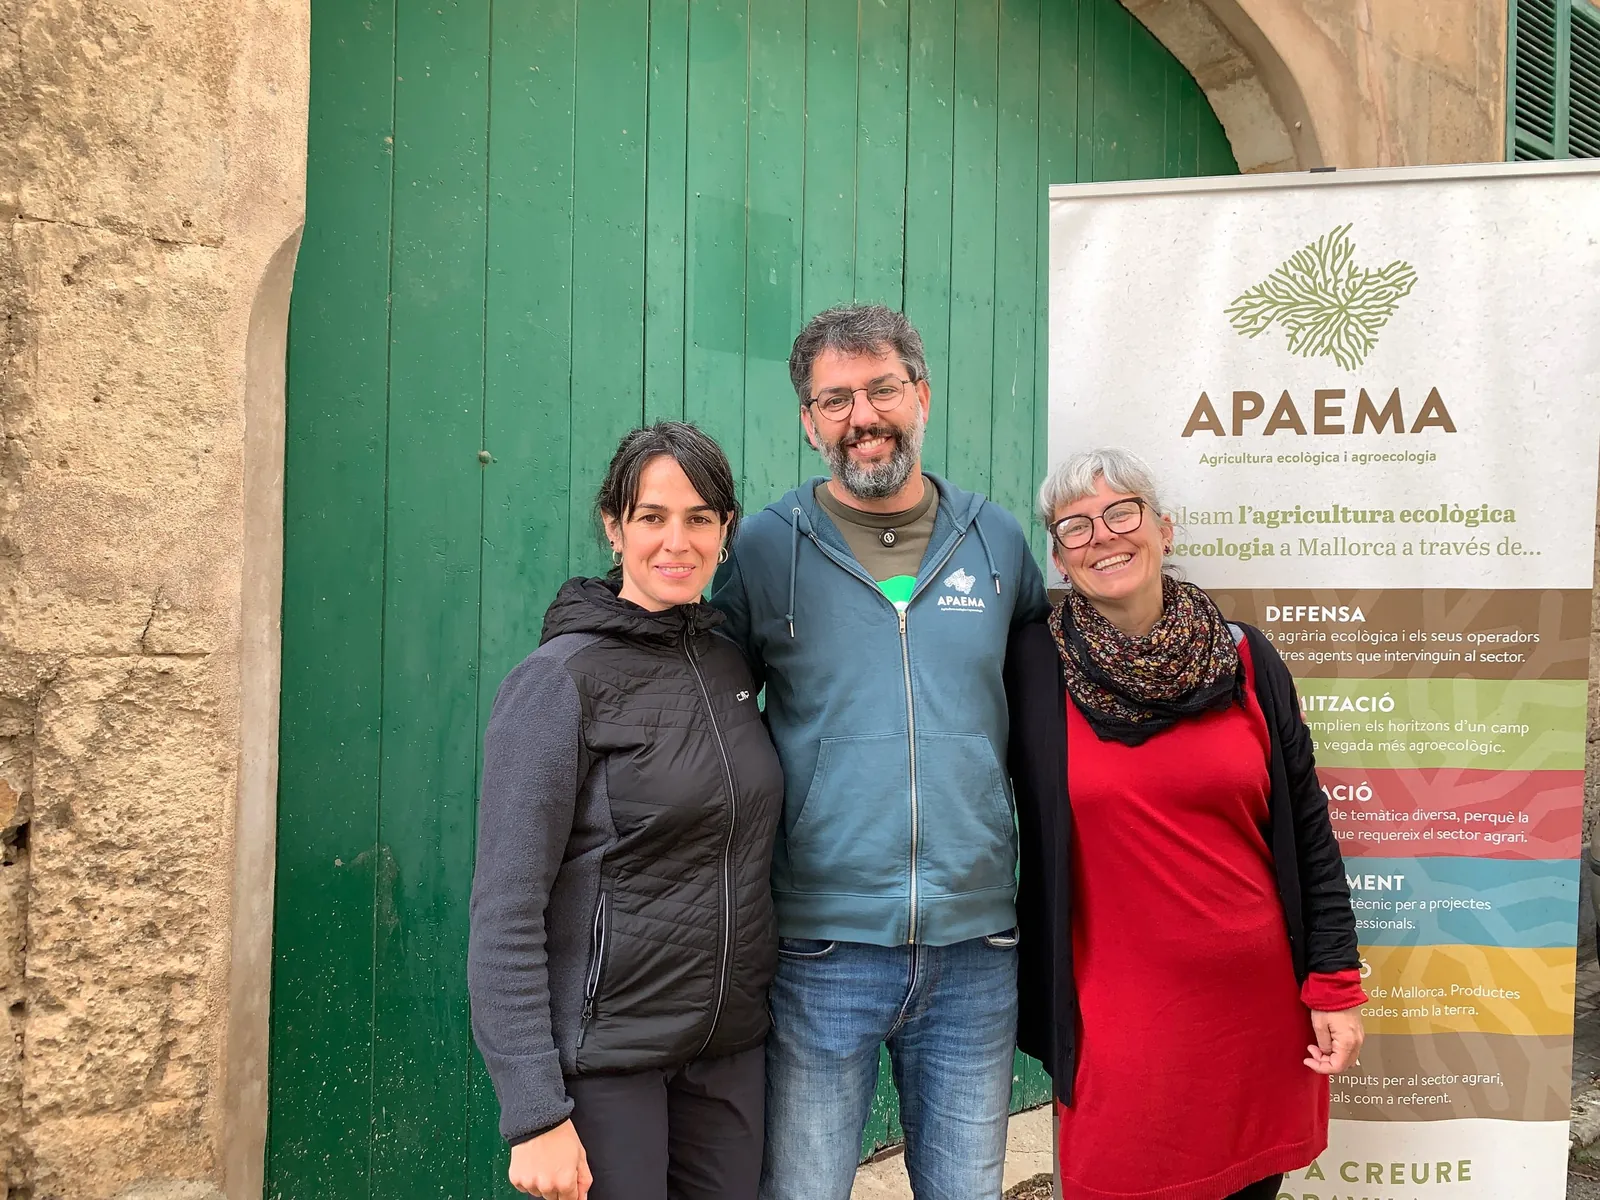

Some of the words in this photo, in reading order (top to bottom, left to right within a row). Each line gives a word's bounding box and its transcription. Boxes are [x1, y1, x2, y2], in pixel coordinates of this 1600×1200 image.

[1181, 387, 1457, 437] APAEMA
[1199, 453, 1272, 467] Agricultura
[1277, 452, 1339, 465] ecològica
[1343, 452, 1348, 464] i
[1352, 450, 1436, 465] agroecologia
[1400, 504, 1516, 527] ecològica
[1280, 543, 1291, 556] a
[1298, 537, 1396, 556] Mallorca
[1403, 542, 1413, 555] a
[1419, 536, 1490, 555] través
[937, 595, 986, 609] APAEMA
[1267, 606, 1365, 622] DEFENSA
[1279, 630, 1326, 644] agrària
[1331, 630, 1397, 645] ecològica
[1402, 629, 1406, 642] i
[1410, 630, 1427, 641] els
[1431, 633, 1462, 641] seus
[1467, 631, 1539, 645] operadors
[1308, 651, 1352, 664] agents
[1356, 653, 1381, 664] que
[1385, 649, 1460, 664] intervinguin
[1465, 650, 1475, 661] al
[1480, 652, 1525, 662] sector.
[1366, 720, 1384, 731] els
[1389, 720, 1449, 731] horitzons
[1491, 723, 1530, 736] camp
[1323, 739, 1374, 754] vegada
[1379, 740, 1405, 751] més
[1409, 739, 1505, 755] agroecològic.
[1330, 808, 1347, 820] de
[1351, 810, 1408, 821] temàtica
[1412, 809, 1460, 822] diversa,
[1465, 812, 1514, 825] perquè
[1519, 812, 1528, 823] la
[1359, 829, 1420, 843] requereix
[1423, 828, 1433, 839] el
[1437, 829, 1481, 840] sector
[1484, 831, 1527, 845] agrari.
[1350, 898, 1391, 910] tècnic
[1396, 901, 1417, 913] per
[1420, 901, 1426, 909] a
[1430, 897, 1491, 912] projectes
[1356, 918, 1415, 929] essionals.
[1371, 986, 1387, 997] de
[1392, 986, 1447, 998] Mallorca.
[1451, 984, 1520, 1000] Productes
[1360, 1005, 1399, 1018] cades
[1402, 1005, 1429, 1017] amb
[1432, 1005, 1441, 1016] la
[1444, 1005, 1478, 1015] terra.
[1339, 1074, 1380, 1088] inputs
[1383, 1076, 1405, 1089] per
[1408, 1074, 1417, 1085] al
[1422, 1074, 1459, 1085] sector
[1462, 1073, 1503, 1086] agrari,
[1354, 1096, 1383, 1104] com
[1387, 1096, 1393, 1104] a
[1398, 1093, 1451, 1104] referent.
[1340, 1160, 1471, 1184] CREURE
